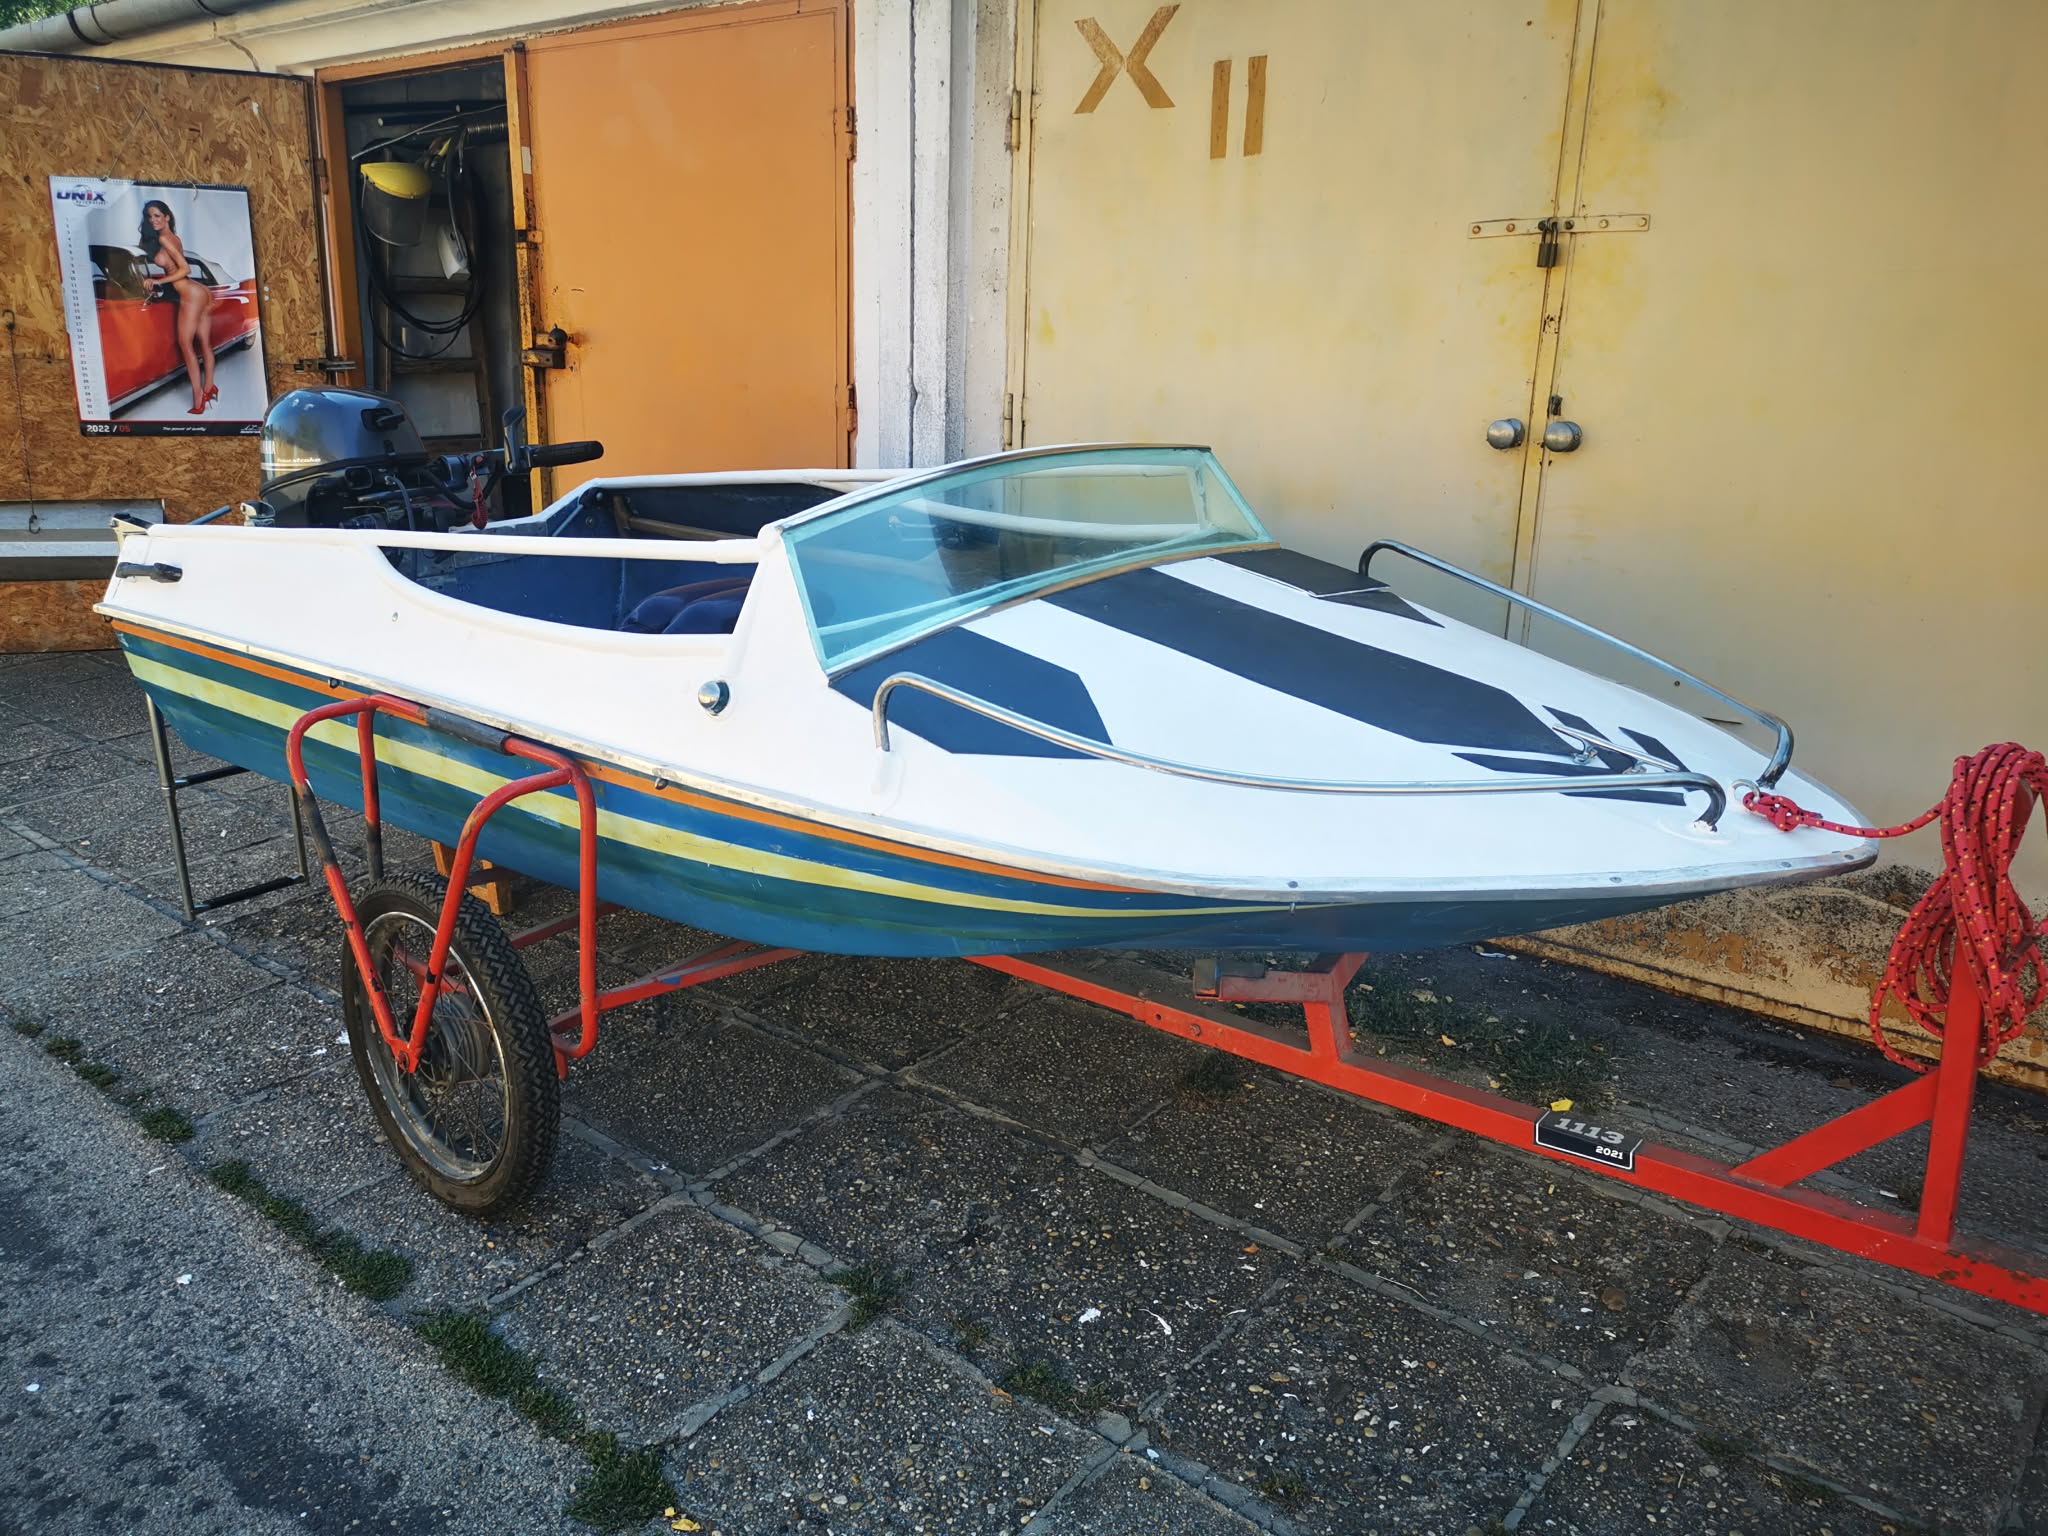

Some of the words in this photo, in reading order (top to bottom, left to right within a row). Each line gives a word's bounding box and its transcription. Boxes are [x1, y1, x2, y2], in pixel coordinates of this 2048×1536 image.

[57, 192, 105, 201] UNIX
[87, 424, 110, 433] 2022
[119, 425, 131, 433] 05
[1554, 1118, 1625, 1145] 1113
[1595, 1145, 1624, 1160] 2021
